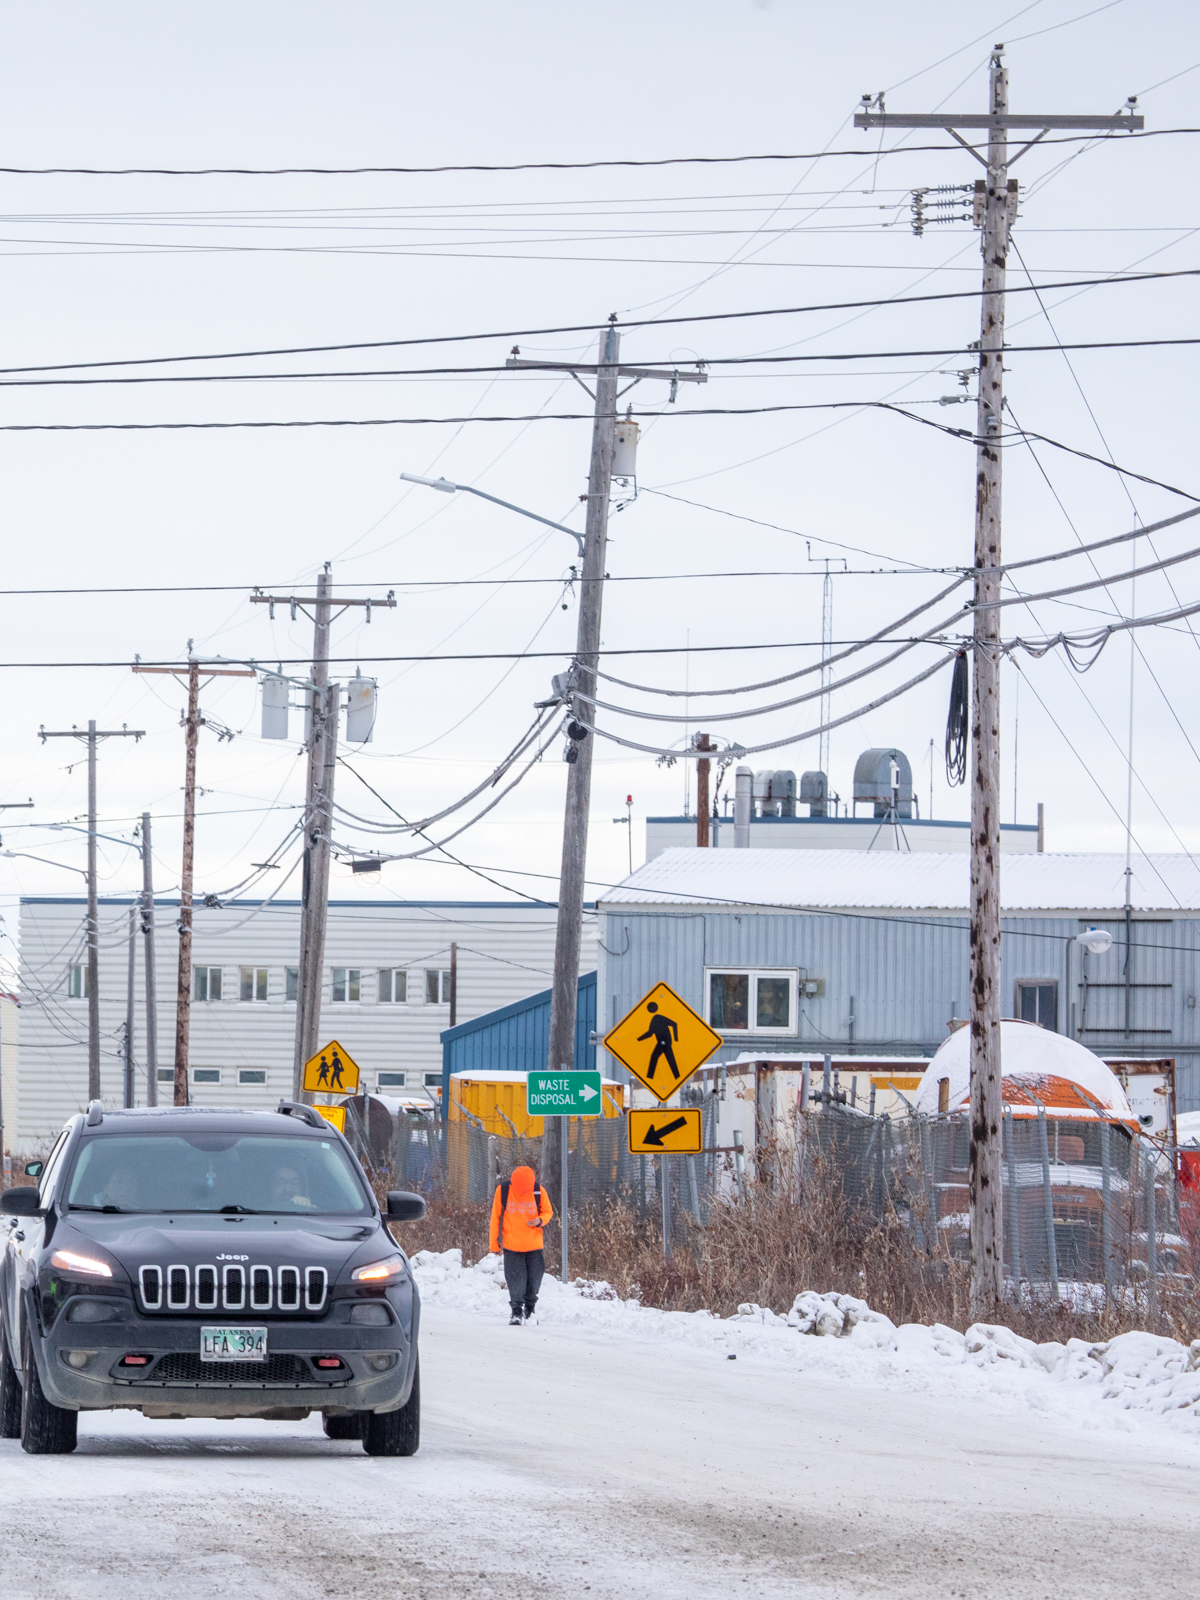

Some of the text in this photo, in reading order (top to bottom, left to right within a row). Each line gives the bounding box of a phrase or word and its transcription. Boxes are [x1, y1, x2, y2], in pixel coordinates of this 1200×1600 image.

[538, 1079, 570, 1091] WASTE
[531, 1093, 577, 1105] DISPOSAL
[216, 1253, 249, 1262] Jeep
[204, 1336, 263, 1353] LFA 394
